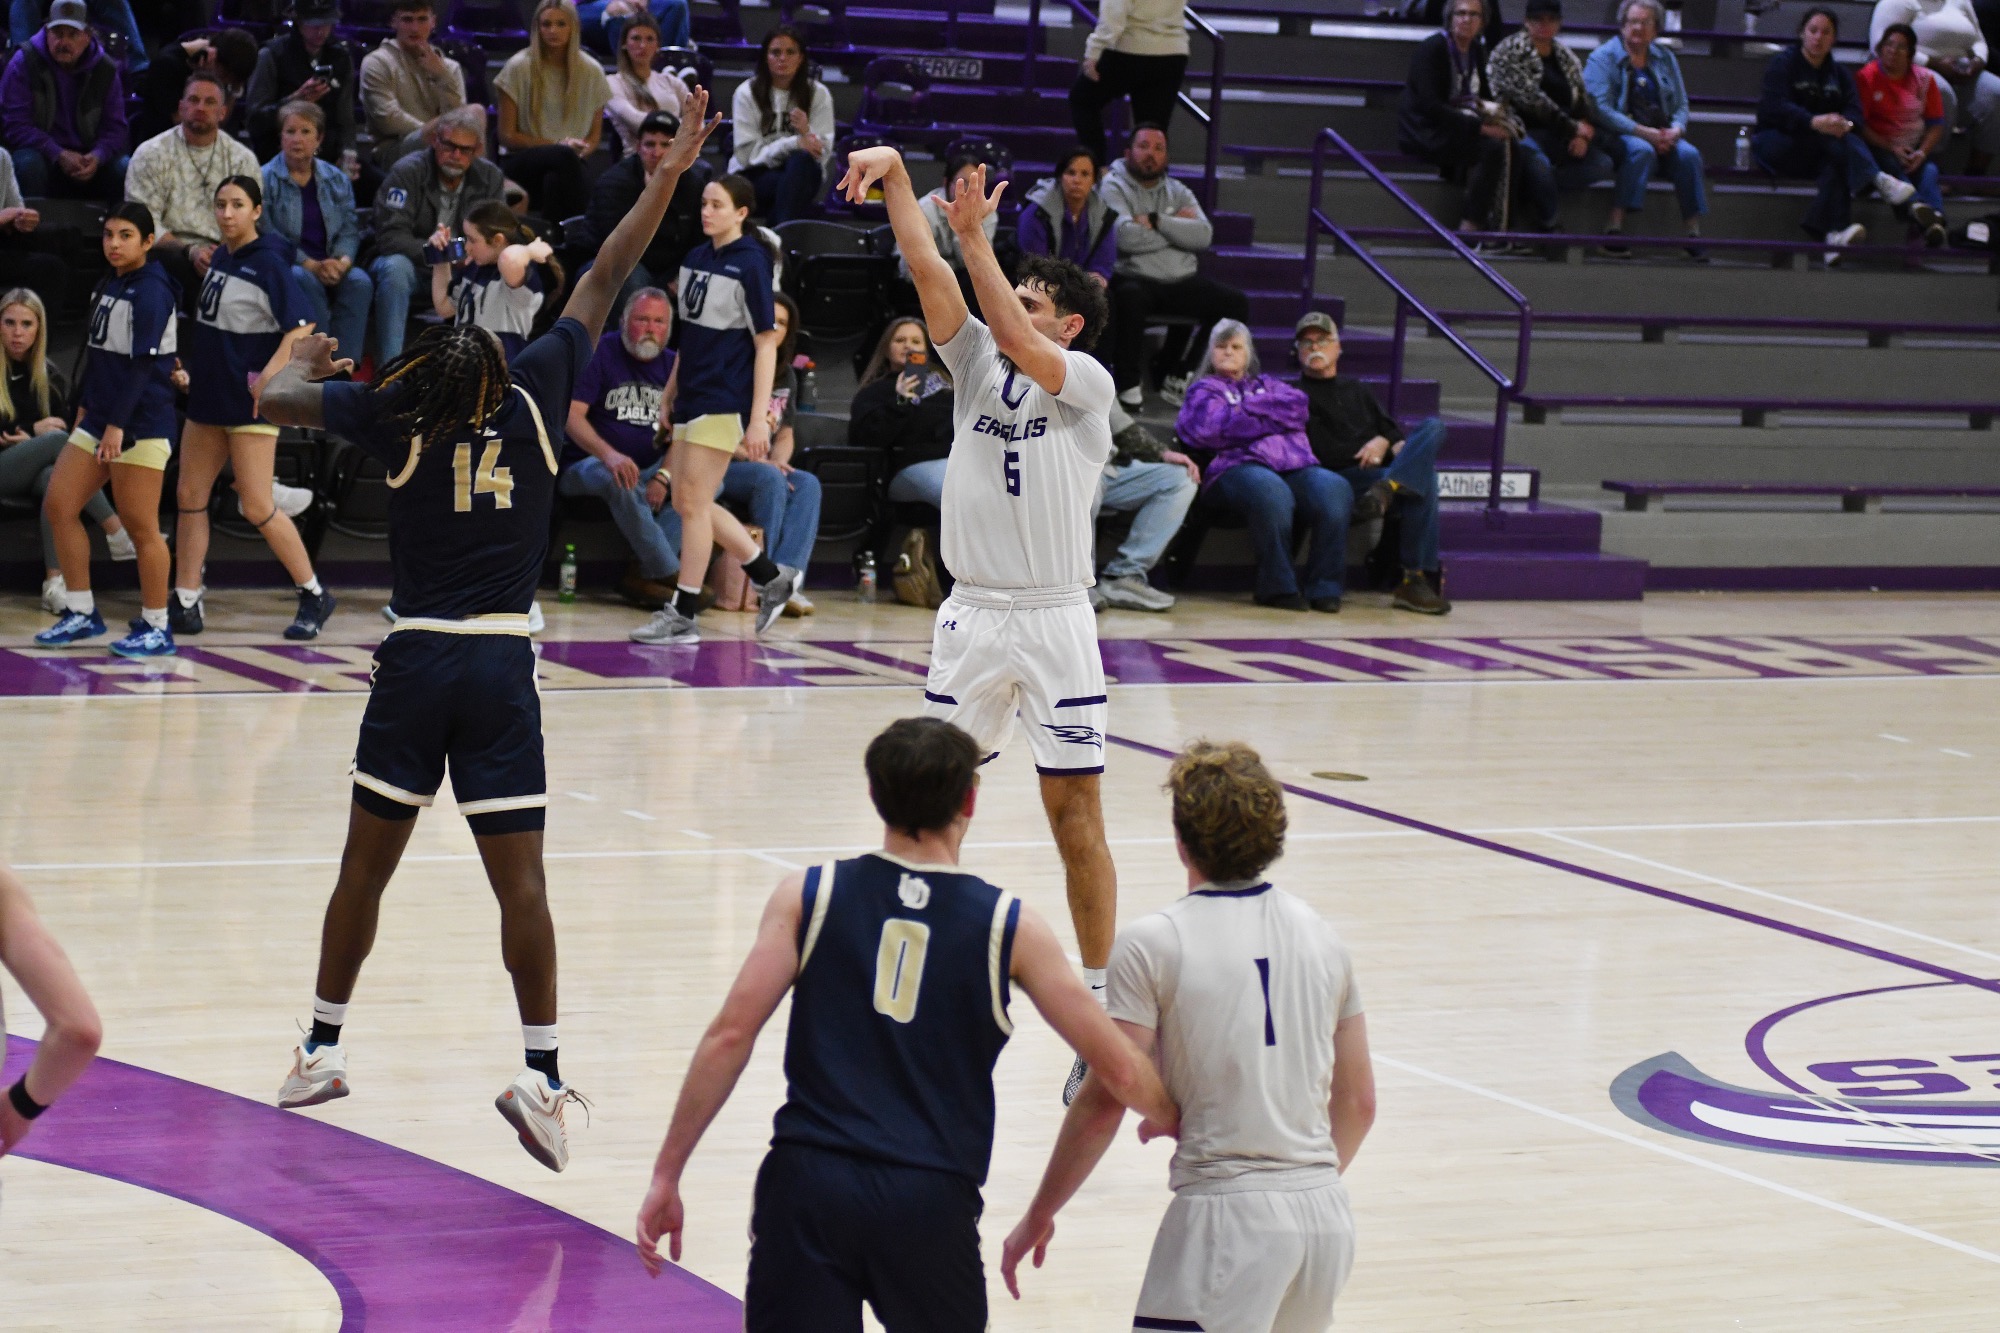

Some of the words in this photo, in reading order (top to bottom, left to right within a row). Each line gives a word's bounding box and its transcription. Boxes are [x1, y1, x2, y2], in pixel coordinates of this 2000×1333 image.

[604, 385, 664, 410] OZARK
[452, 438, 515, 512] 14
[1440, 475, 1516, 495] Athletcs
[1147, 636, 2000, 683] ERSITY
[873, 917, 931, 1024] 0
[1253, 957, 1276, 1047] 1
